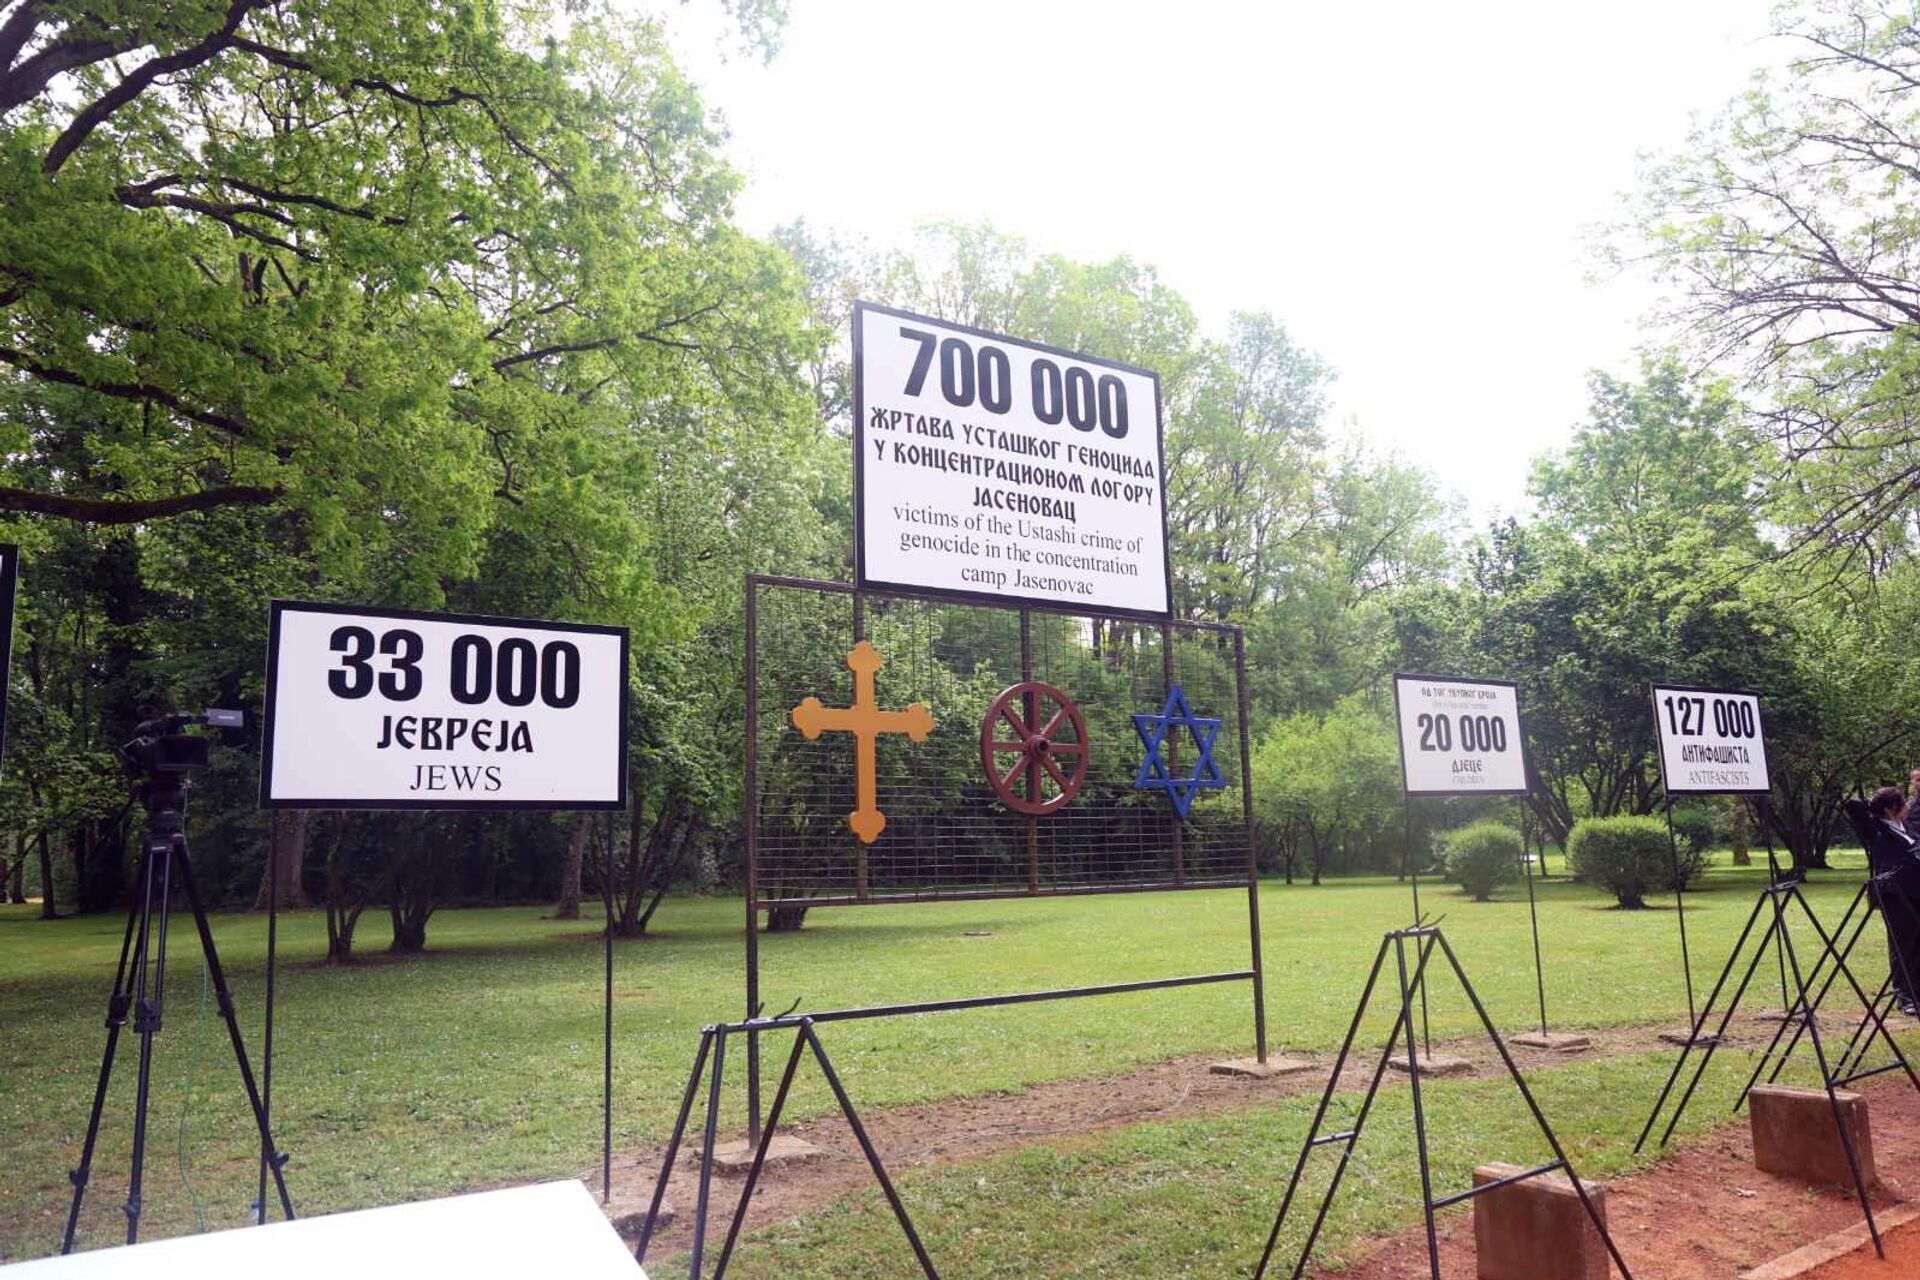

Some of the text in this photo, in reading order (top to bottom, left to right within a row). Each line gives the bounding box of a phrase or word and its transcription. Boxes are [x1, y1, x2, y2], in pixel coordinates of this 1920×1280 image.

[900, 327, 1129, 439] 700 000
[870, 406, 1154, 479] ЖРТАВА УСТАШКОГ ГЕНОЦИДА
[874, 439, 1153, 506] У КОНЦЕНТРАЦИОНОМ ЛОГОРУ
[973, 486, 1076, 524] ЈАСЕНОВАЦ
[893, 502, 1143, 554] victims of the Ustashi crime of
[900, 532, 1138, 576] genocide in the concentration
[961, 567, 1094, 595] camp Jasenovac
[328, 625, 580, 709] 33 000
[376, 715, 534, 753] ЈЕВРЕЈА
[1418, 713, 1506, 752] 20 000
[1664, 696, 1755, 739] 127 000
[1682, 744, 1750, 764] АНТИФАШИСТА
[410, 765, 502, 792] JEWS
[1689, 770, 1750, 785] ANTIFASCISTS
